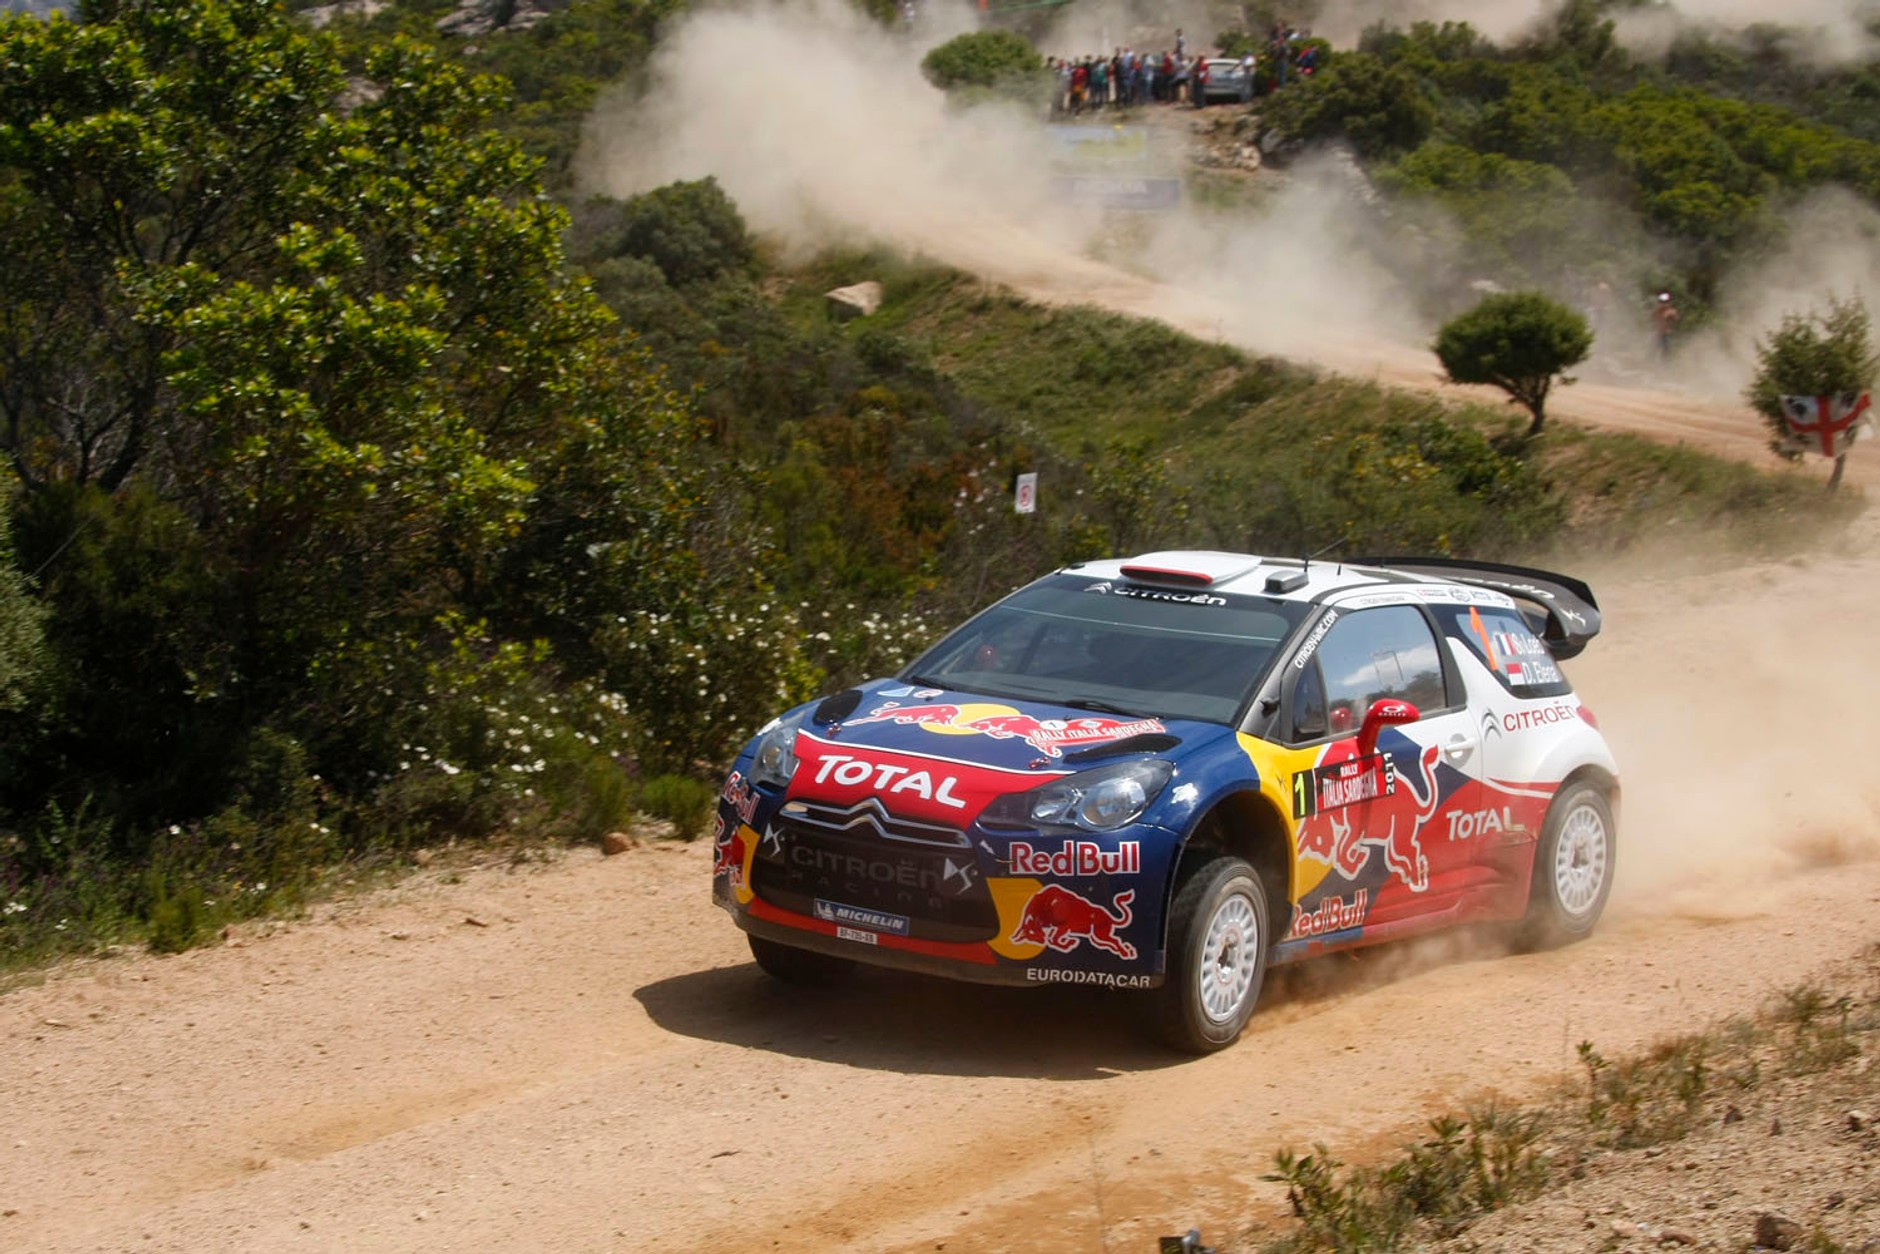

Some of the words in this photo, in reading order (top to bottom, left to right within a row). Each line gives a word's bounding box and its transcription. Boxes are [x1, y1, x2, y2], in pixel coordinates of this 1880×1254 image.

[1469, 604, 1497, 671] 1
[814, 754, 967, 809] TOTAL
[1383, 752, 1395, 794] 2011
[1294, 773, 1306, 816] 1
[1446, 805, 1525, 842] TOTAL
[836, 907, 905, 930] MICHELIN
[1026, 967, 1151, 988] EURODATACAR
